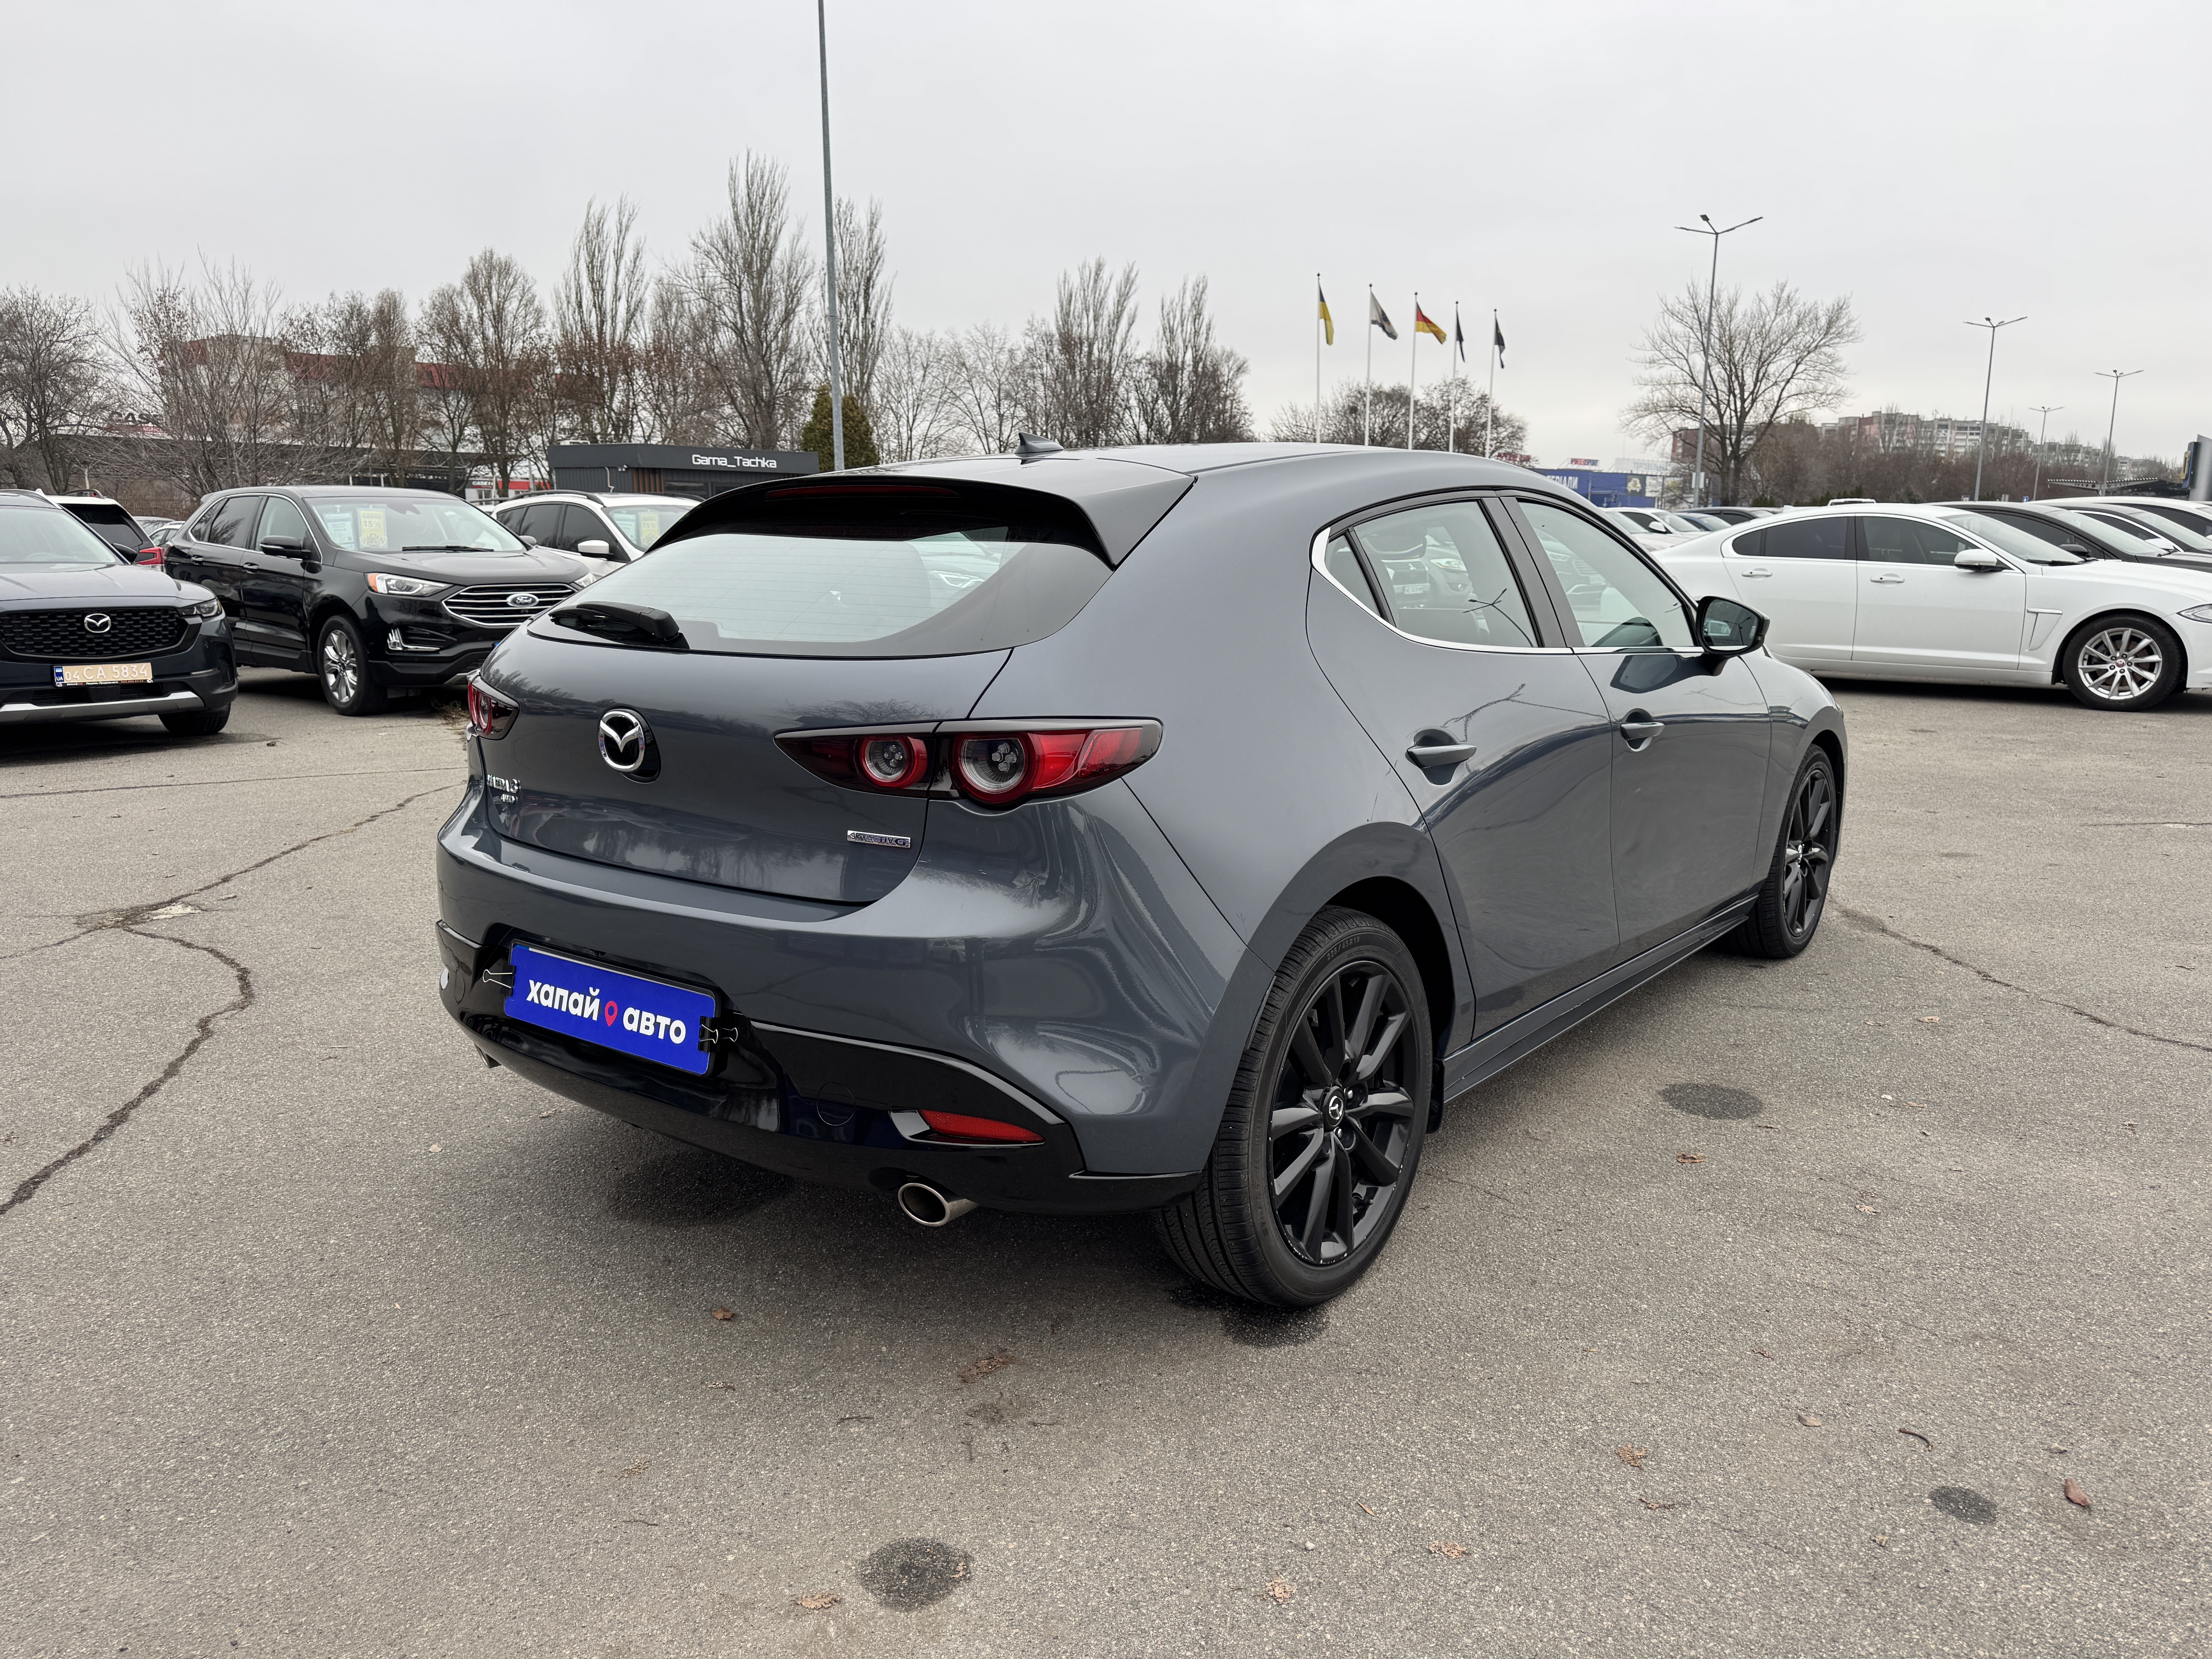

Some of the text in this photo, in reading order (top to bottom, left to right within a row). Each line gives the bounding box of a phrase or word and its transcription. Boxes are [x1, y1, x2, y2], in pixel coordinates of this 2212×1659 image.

[65, 664, 148, 681] 04 CA 5834
[526, 979, 686, 1044] хапай авто
